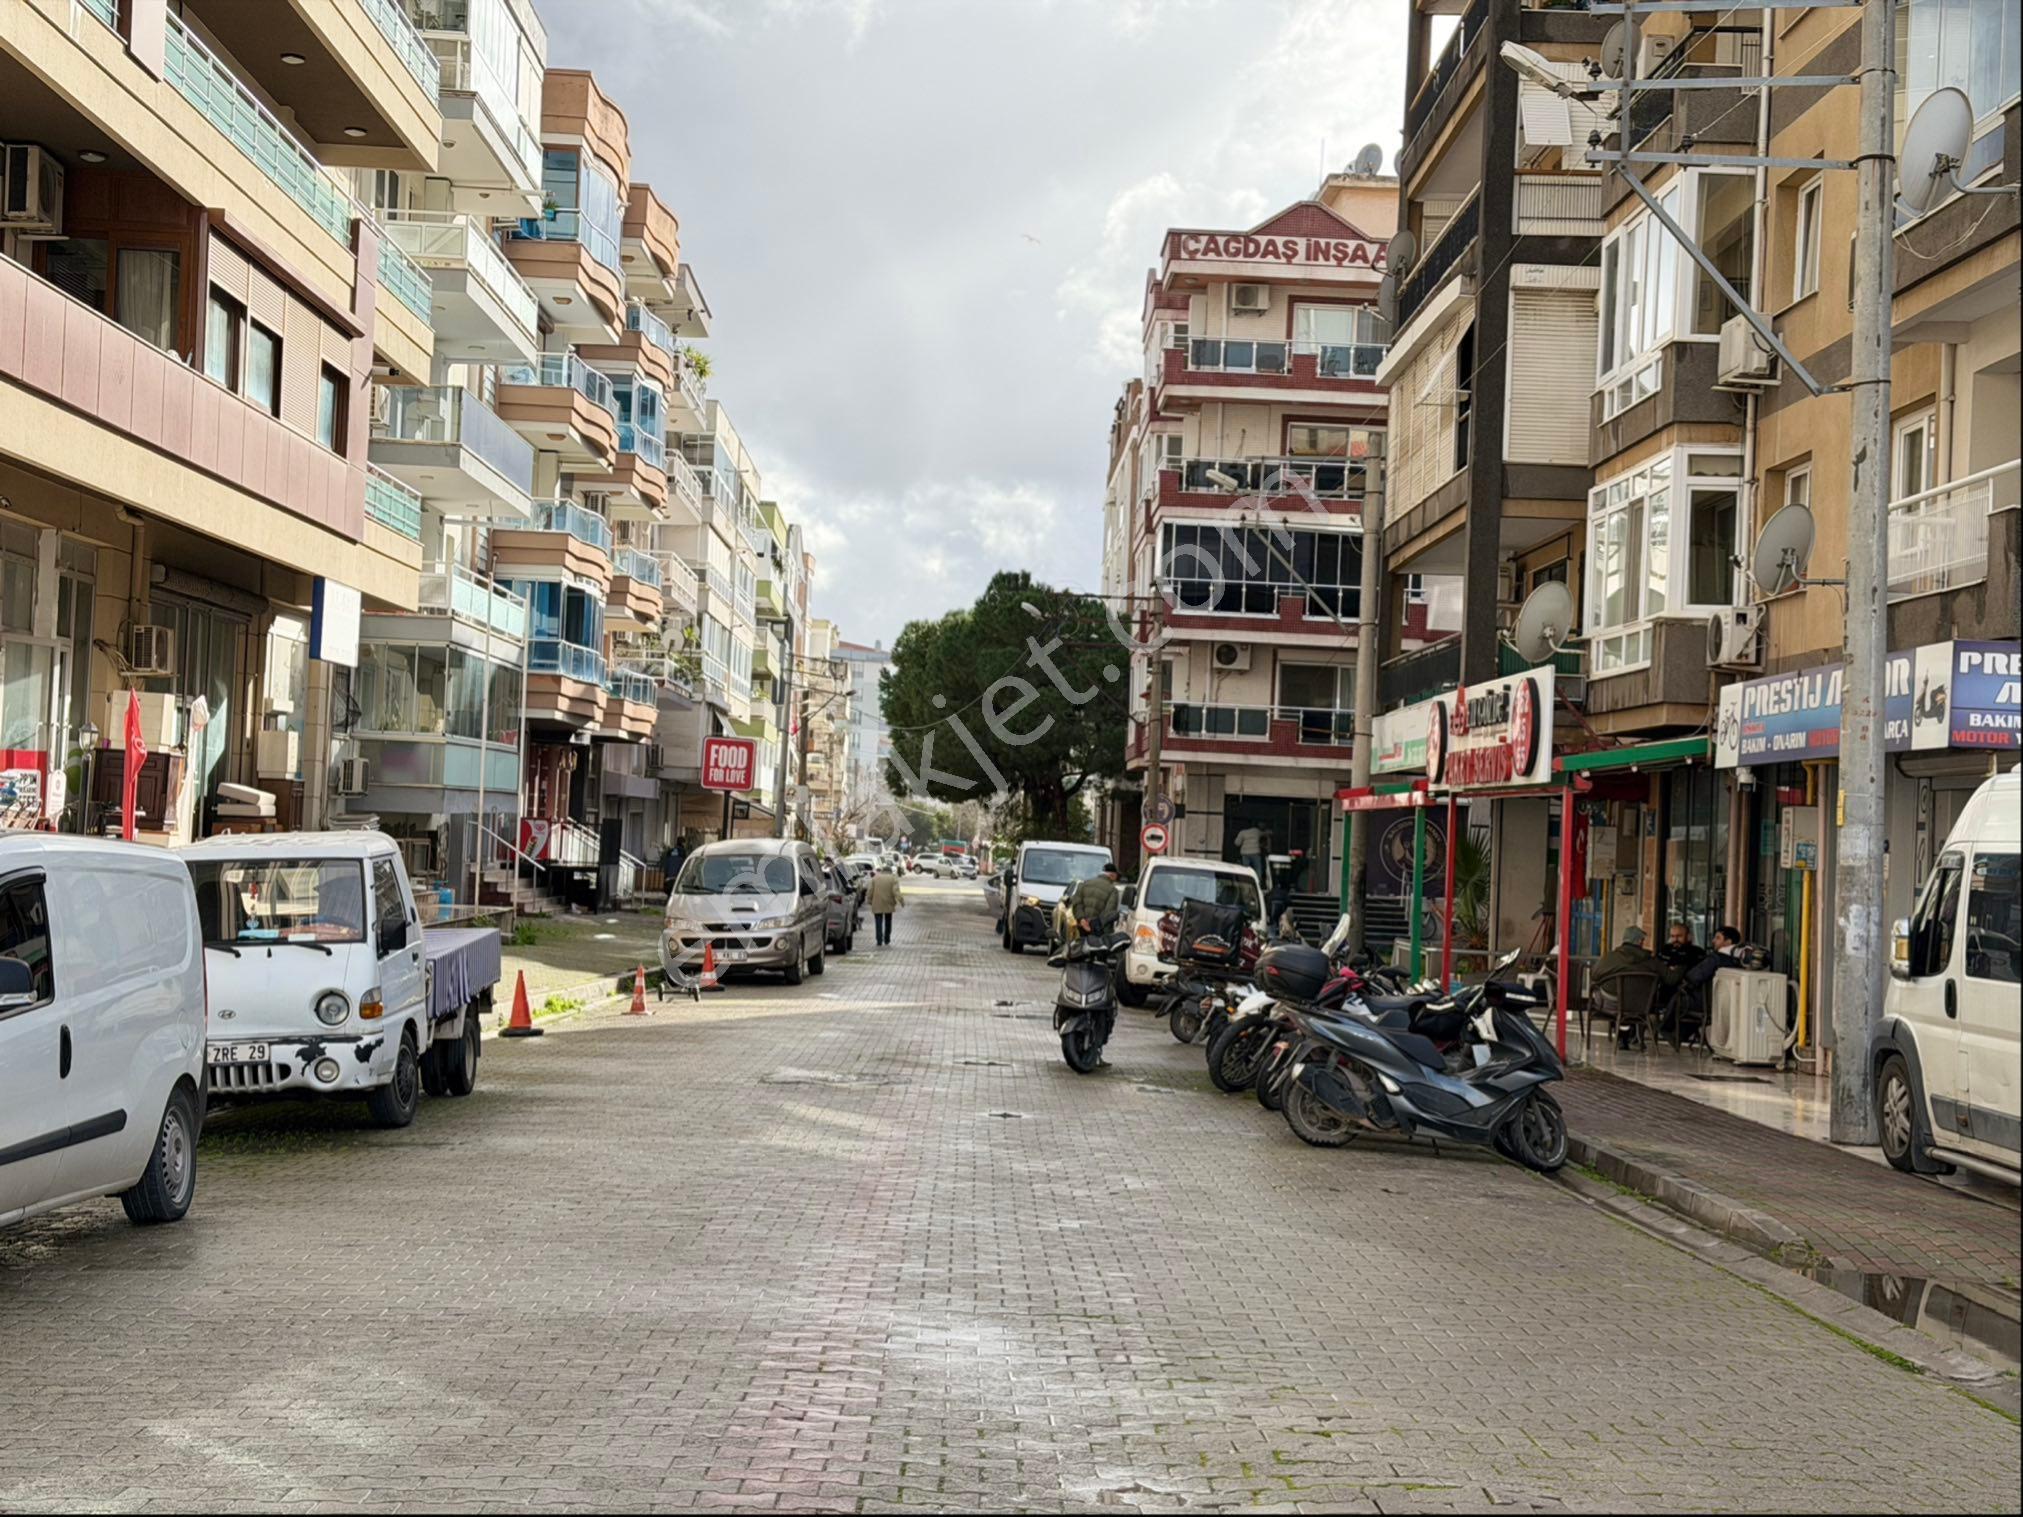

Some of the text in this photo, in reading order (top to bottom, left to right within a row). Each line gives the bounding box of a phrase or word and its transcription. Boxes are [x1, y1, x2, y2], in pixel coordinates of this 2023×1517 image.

[1951, 730, 2011, 745] MOTOR
[710, 744, 748, 769] FOOD
[708, 767, 747, 784] FOR LOVE
[213, 1044, 266, 1063] ZRE 29
